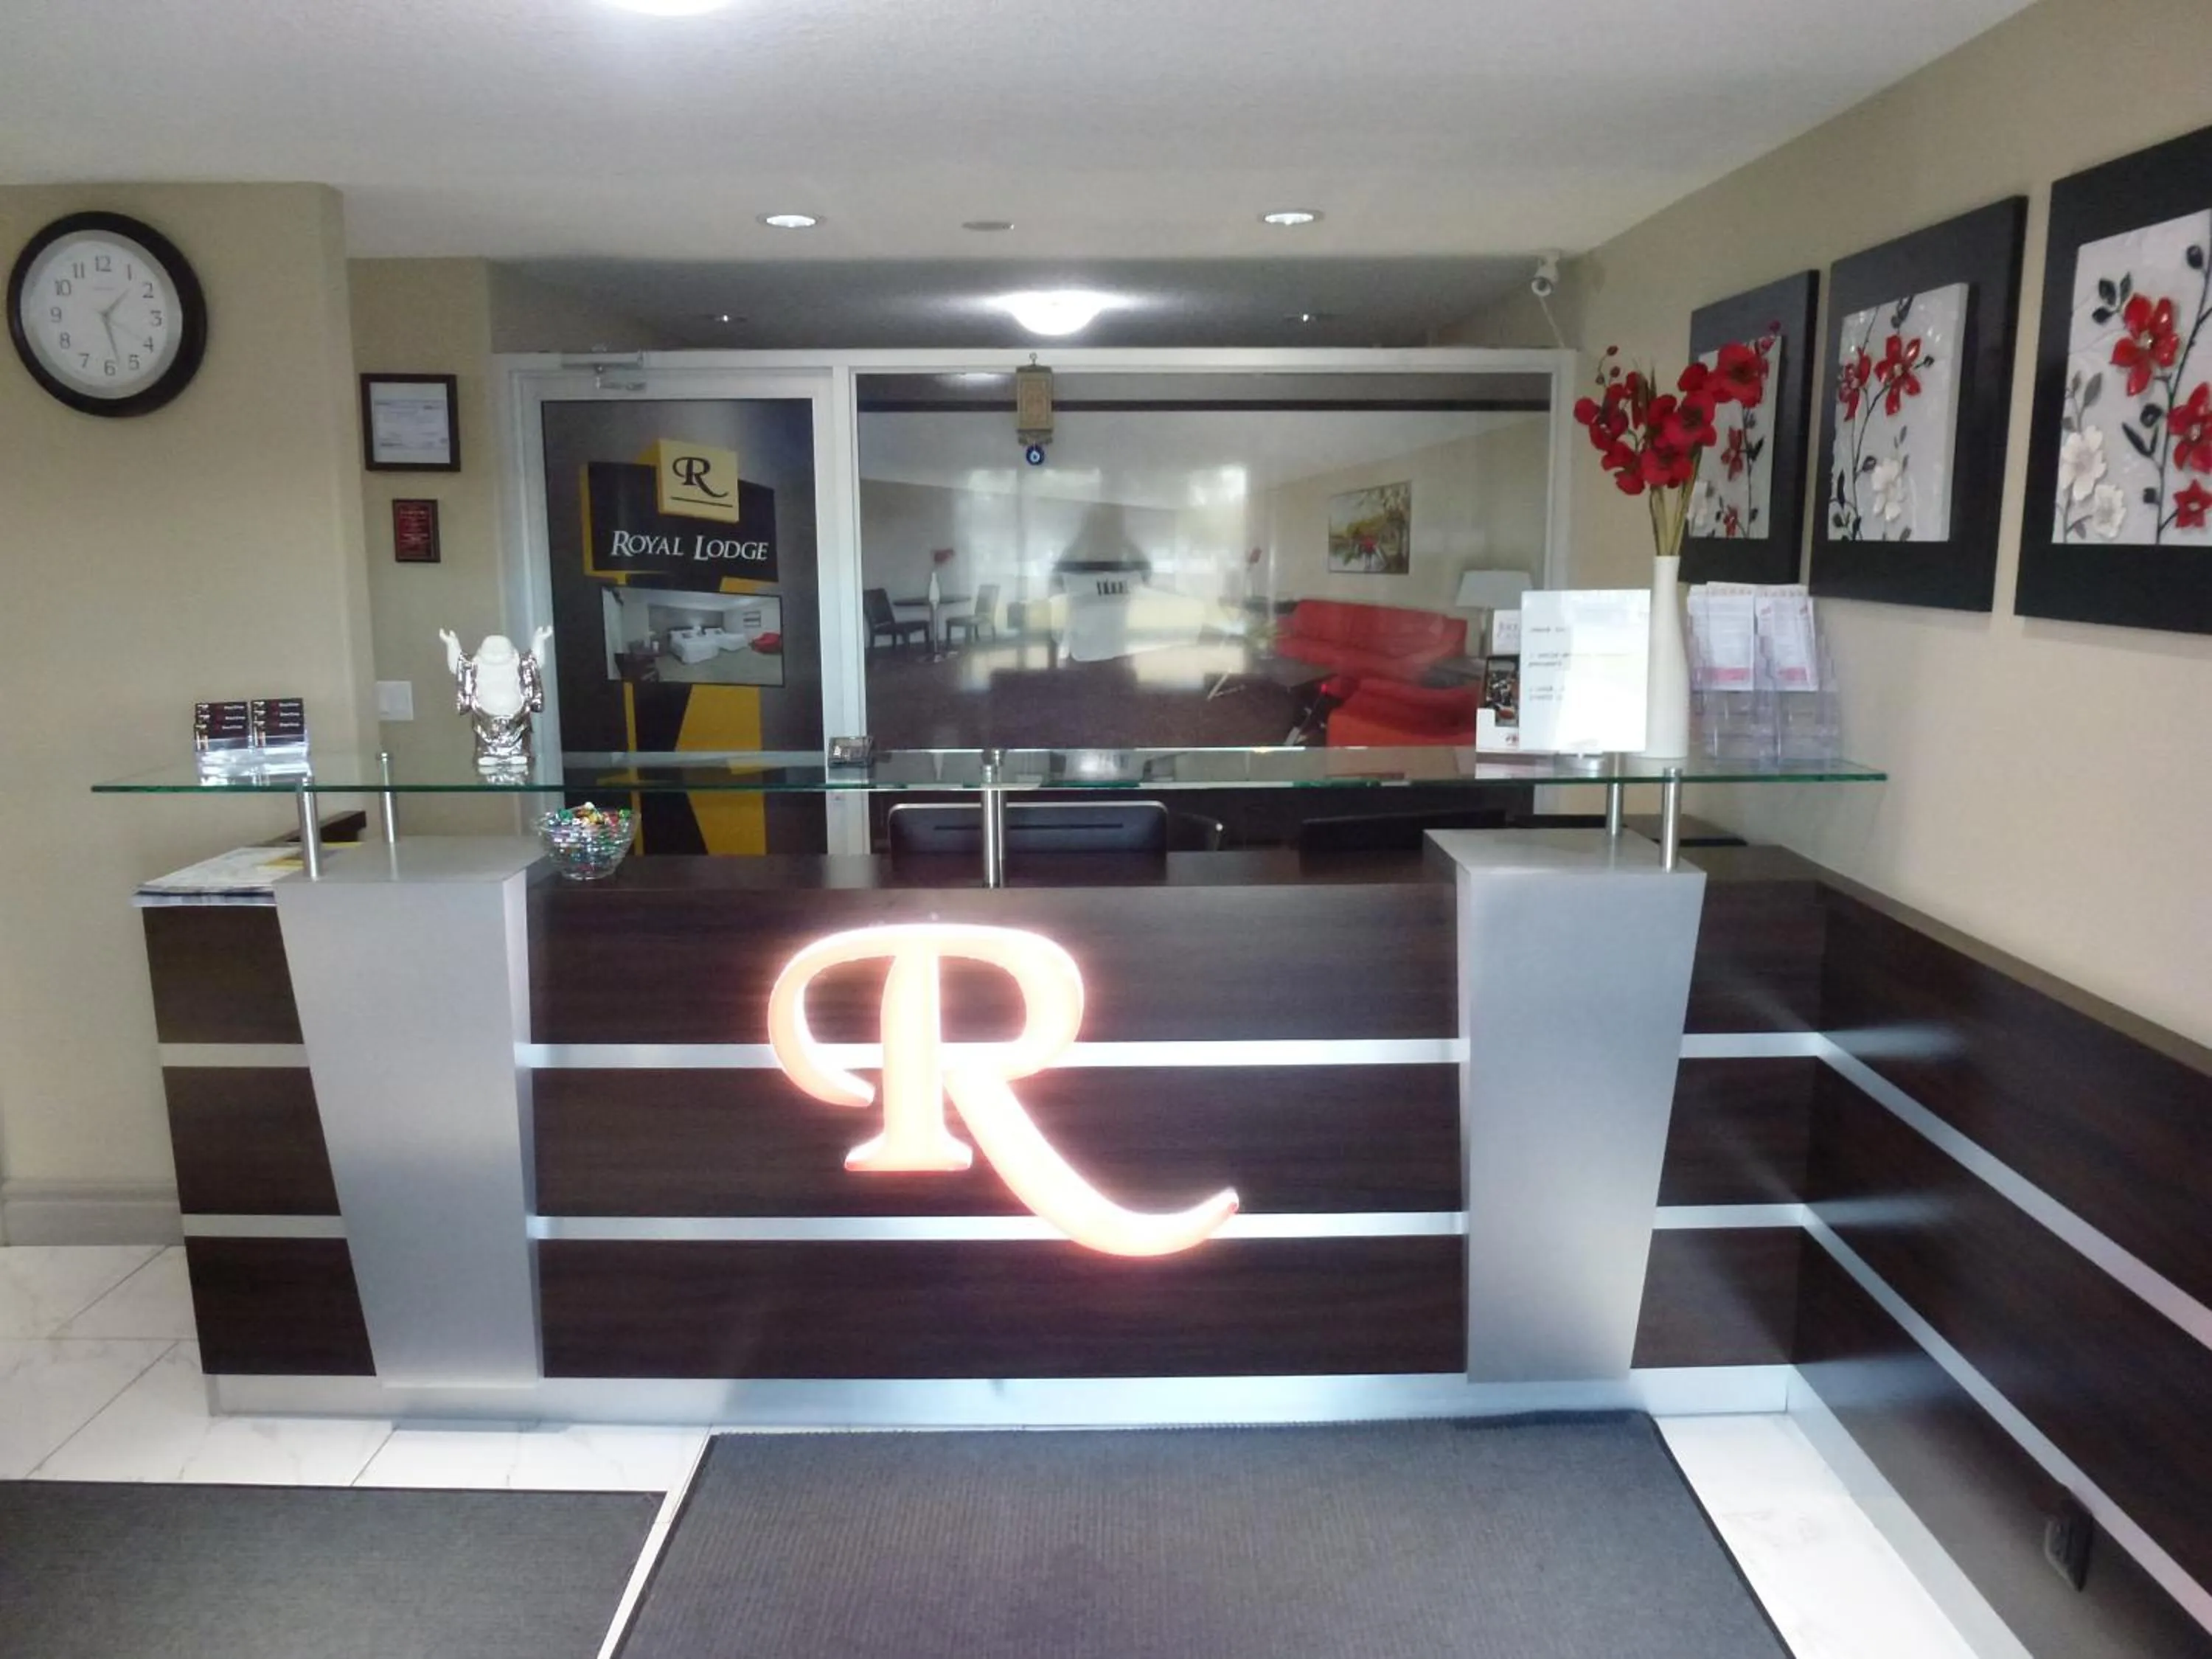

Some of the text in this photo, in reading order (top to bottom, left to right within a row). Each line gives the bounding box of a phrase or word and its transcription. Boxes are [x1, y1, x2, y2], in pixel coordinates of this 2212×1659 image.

[73, 262, 86, 279] 11
[94, 255, 111, 272] 12
[55, 279, 72, 296] 10
[142, 282, 154, 299] 2
[50, 307, 63, 323] 9
[150, 310, 162, 327] 3
[60, 332, 71, 349] 8
[142, 335, 154, 353] 4
[78, 352, 90, 369] 7
[103, 359, 116, 377] 6
[128, 354, 140, 370] 5
[672, 456, 729, 498] R
[611, 530, 769, 562] ROYAL LODGE
[768, 923, 1239, 1256] R
